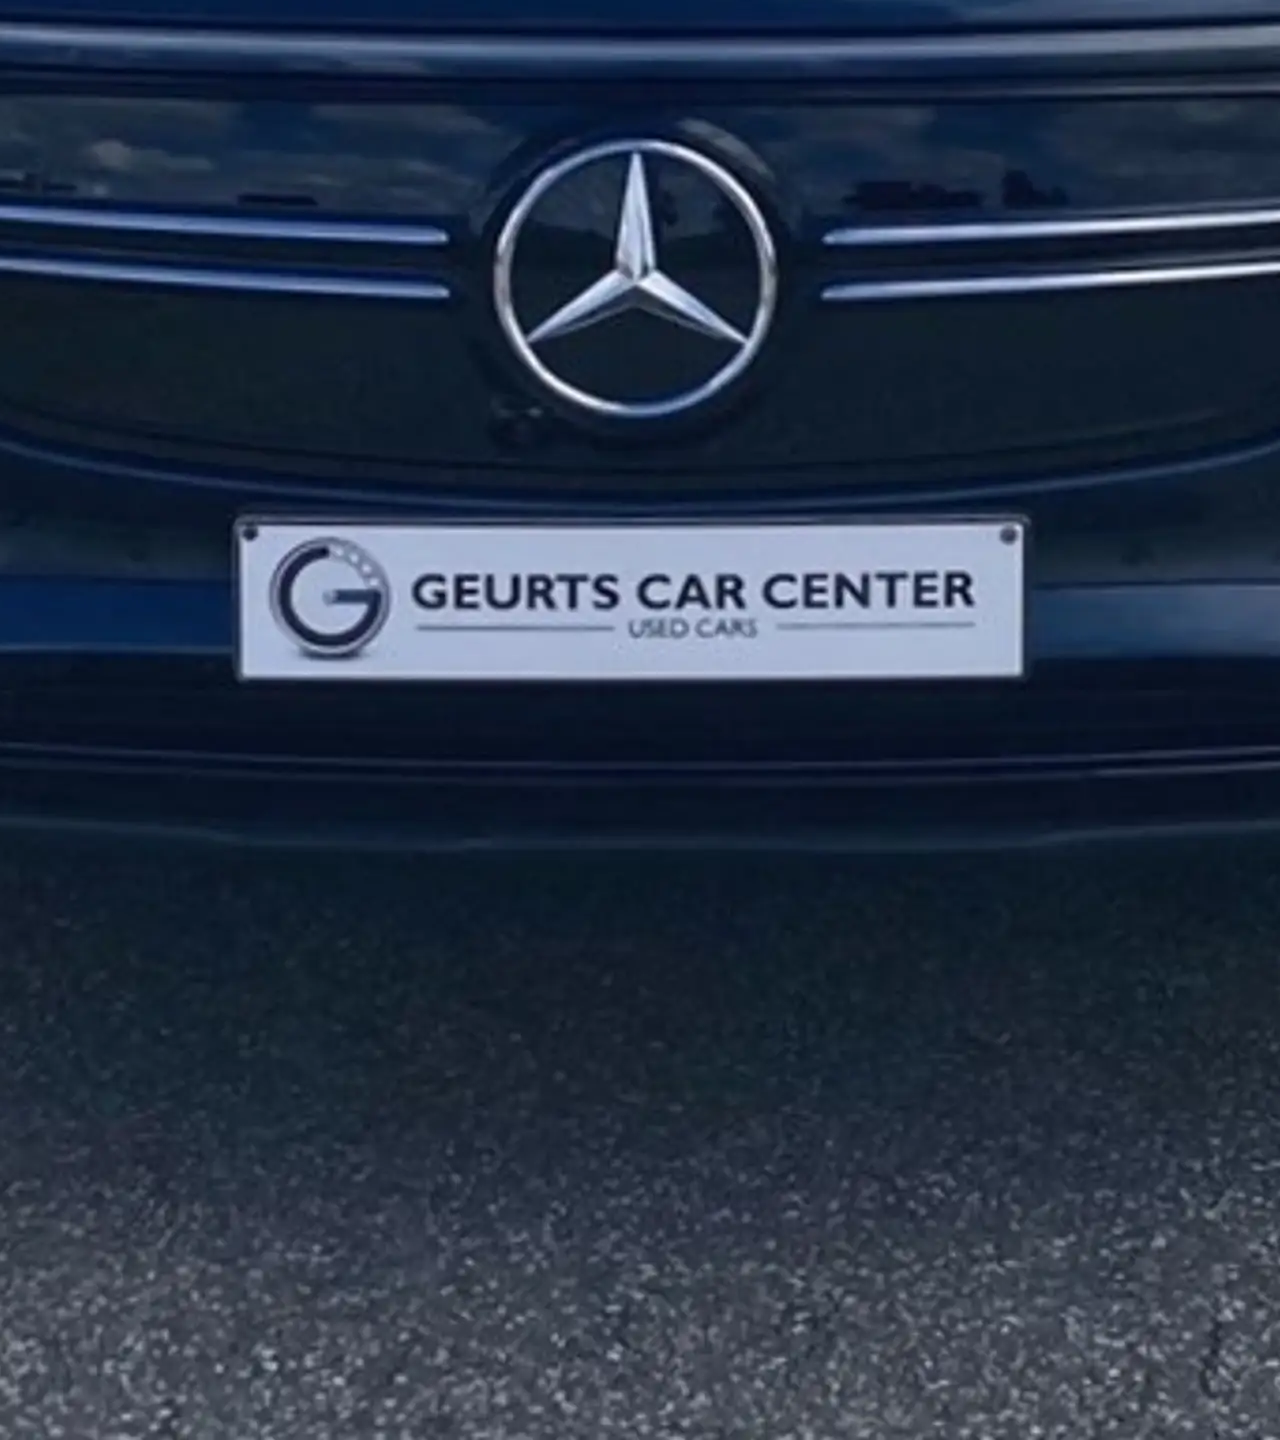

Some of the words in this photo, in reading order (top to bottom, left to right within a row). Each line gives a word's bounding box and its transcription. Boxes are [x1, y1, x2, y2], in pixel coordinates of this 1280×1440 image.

[411, 573, 621, 610] GEURTS
[636, 573, 746, 610] CAR
[762, 571, 975, 609] CENTER
[628, 618, 689, 639] USED
[694, 617, 758, 638] CARS
